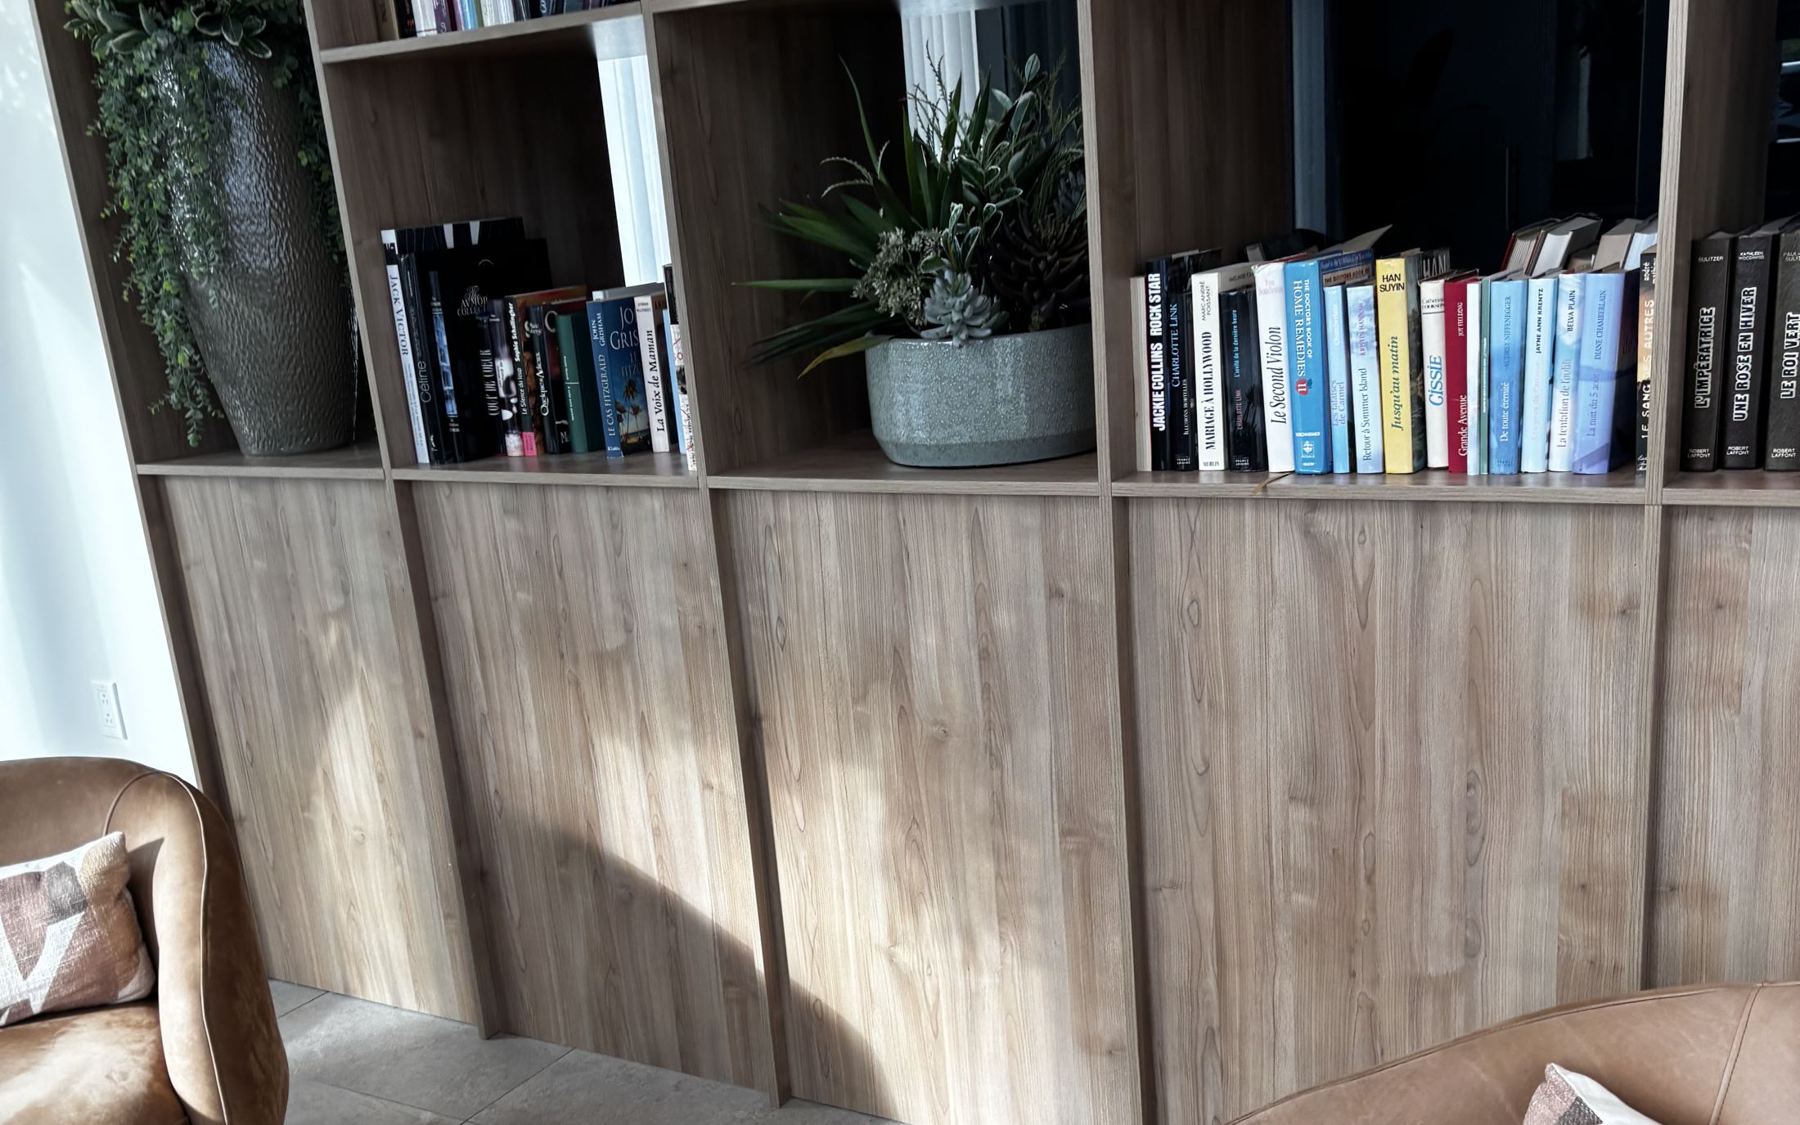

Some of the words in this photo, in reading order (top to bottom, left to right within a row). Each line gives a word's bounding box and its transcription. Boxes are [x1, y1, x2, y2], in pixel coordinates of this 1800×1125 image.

[390, 275, 402, 305] JACK
[1147, 273, 1161, 305] STAR
[1379, 282, 1405, 293] SUYIN
[1382, 273, 1401, 283] HAN
[1293, 280, 1303, 316] HOME
[1304, 293, 1312, 326] DOCTORS
[1568, 290, 1576, 310] PLAIN
[1740, 287, 1757, 330] HIVER
[619, 307, 634, 330] JO
[1149, 305, 1163, 336] ROCK
[1168, 303, 1178, 327] LINK
[1566, 311, 1575, 332] BELVA
[1595, 290, 1606, 338] CHAMBERLAIN
[1645, 299, 1655, 350] AUTRES
[395, 306, 409, 355] VICTOR
[591, 319, 599, 340] JOHN
[597, 312, 606, 347] GRISHAM
[609, 331, 639, 350] GRIS
[1738, 332, 1754, 352] EN
[1784, 312, 1800, 350] VERT
[513, 343, 521, 363] Sophie
[646, 330, 658, 372] Maman
[1170, 329, 1181, 388] CHARLOTTE
[1264, 327, 1283, 364] Violon
[1295, 319, 1306, 377] REMEDIES
[1306, 349, 1313, 359] OF
[1387, 336, 1399, 374] matin
[1594, 339, 1602, 360] DIANE
[1695, 307, 1715, 408] L'IMPÉRATRICE
[1150, 342, 1166, 390] COLLINS
[1201, 331, 1214, 395] HOLLYWOOD
[1735, 354, 1751, 391] ROSE
[1782, 352, 1798, 379] ROI
[598, 354, 612, 407] FITZGERALD
[647, 375, 660, 389] de
[1266, 366, 1286, 408] Second
[1358, 368, 1368, 392] Island
[1559, 385, 1570, 396] de
[1781, 380, 1796, 399] LE
[518, 388, 527, 406] Silence
[652, 390, 663, 415] Voix
[1335, 382, 1346, 412] Carmel
[1390, 378, 1404, 431] Jusqu'au
[1500, 382, 1510, 409] éternité
[1588, 399, 1598, 409] du
[1733, 394, 1749, 421] UNE
[605, 408, 615, 426] CAS
[1152, 390, 1166, 432] JACKIE
[1270, 409, 1287, 424] Le
[1337, 413, 1346, 425] de
[1359, 394, 1370, 428] Summer
[1458, 394, 1468, 425] Avenue
[1501, 410, 1509, 429] toute
[1558, 398, 1569, 436] tentation
[1588, 411, 1598, 426] nuit
[608, 427, 616, 436] LE
[656, 418, 665, 432] La
[1203, 407, 1216, 450] MARIAGE
[1500, 430, 1509, 442] De
[1587, 427, 1597, 437] La
[1361, 435, 1372, 461] Retour
[1457, 426, 1468, 457] Grande
[1556, 437, 1567, 448] La
